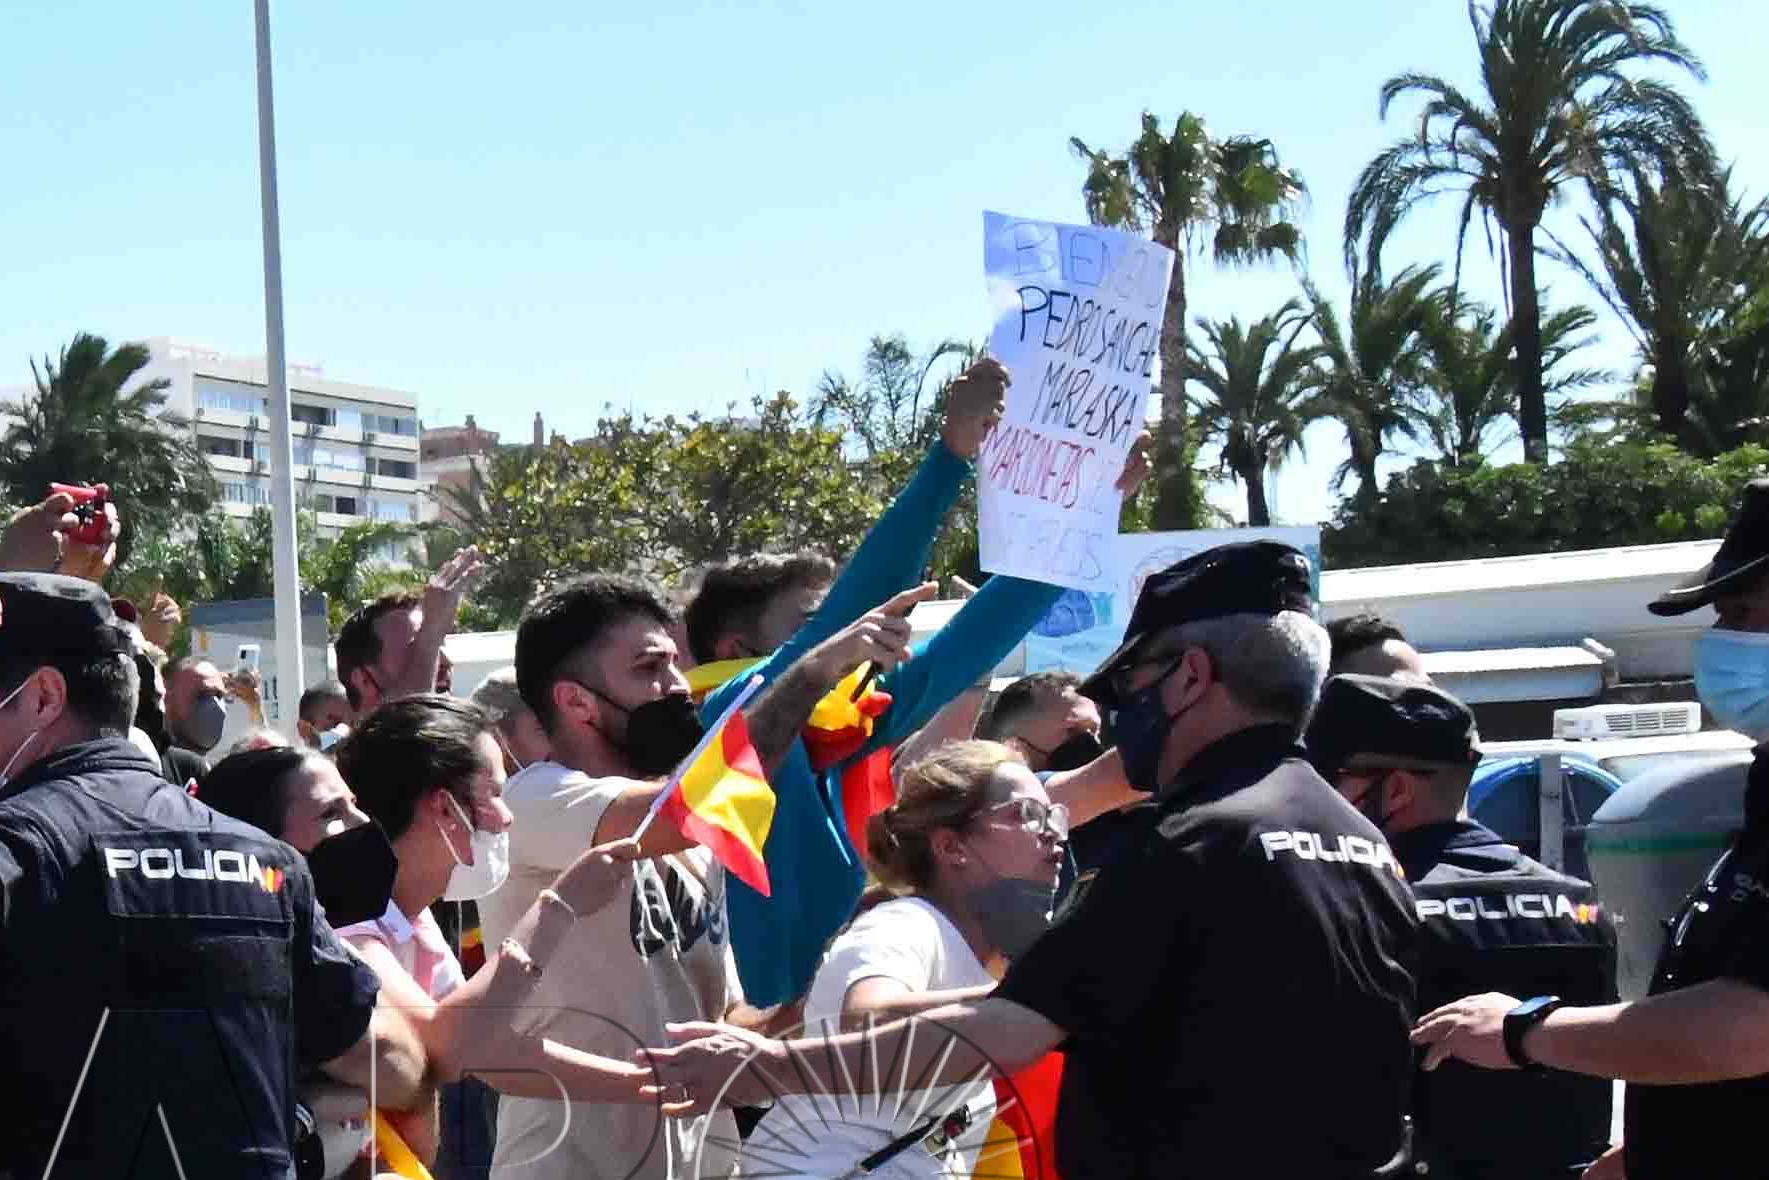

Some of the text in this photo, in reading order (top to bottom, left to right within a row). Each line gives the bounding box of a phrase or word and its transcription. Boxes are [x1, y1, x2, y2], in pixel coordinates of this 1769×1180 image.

[1016, 285, 1103, 359] PEDRO
[1030, 360, 1138, 448] MARLASKA
[104, 847, 267, 891] POLICIA
[1260, 830, 1397, 874] POLICIA
[1414, 894, 1578, 923] POLICIA
